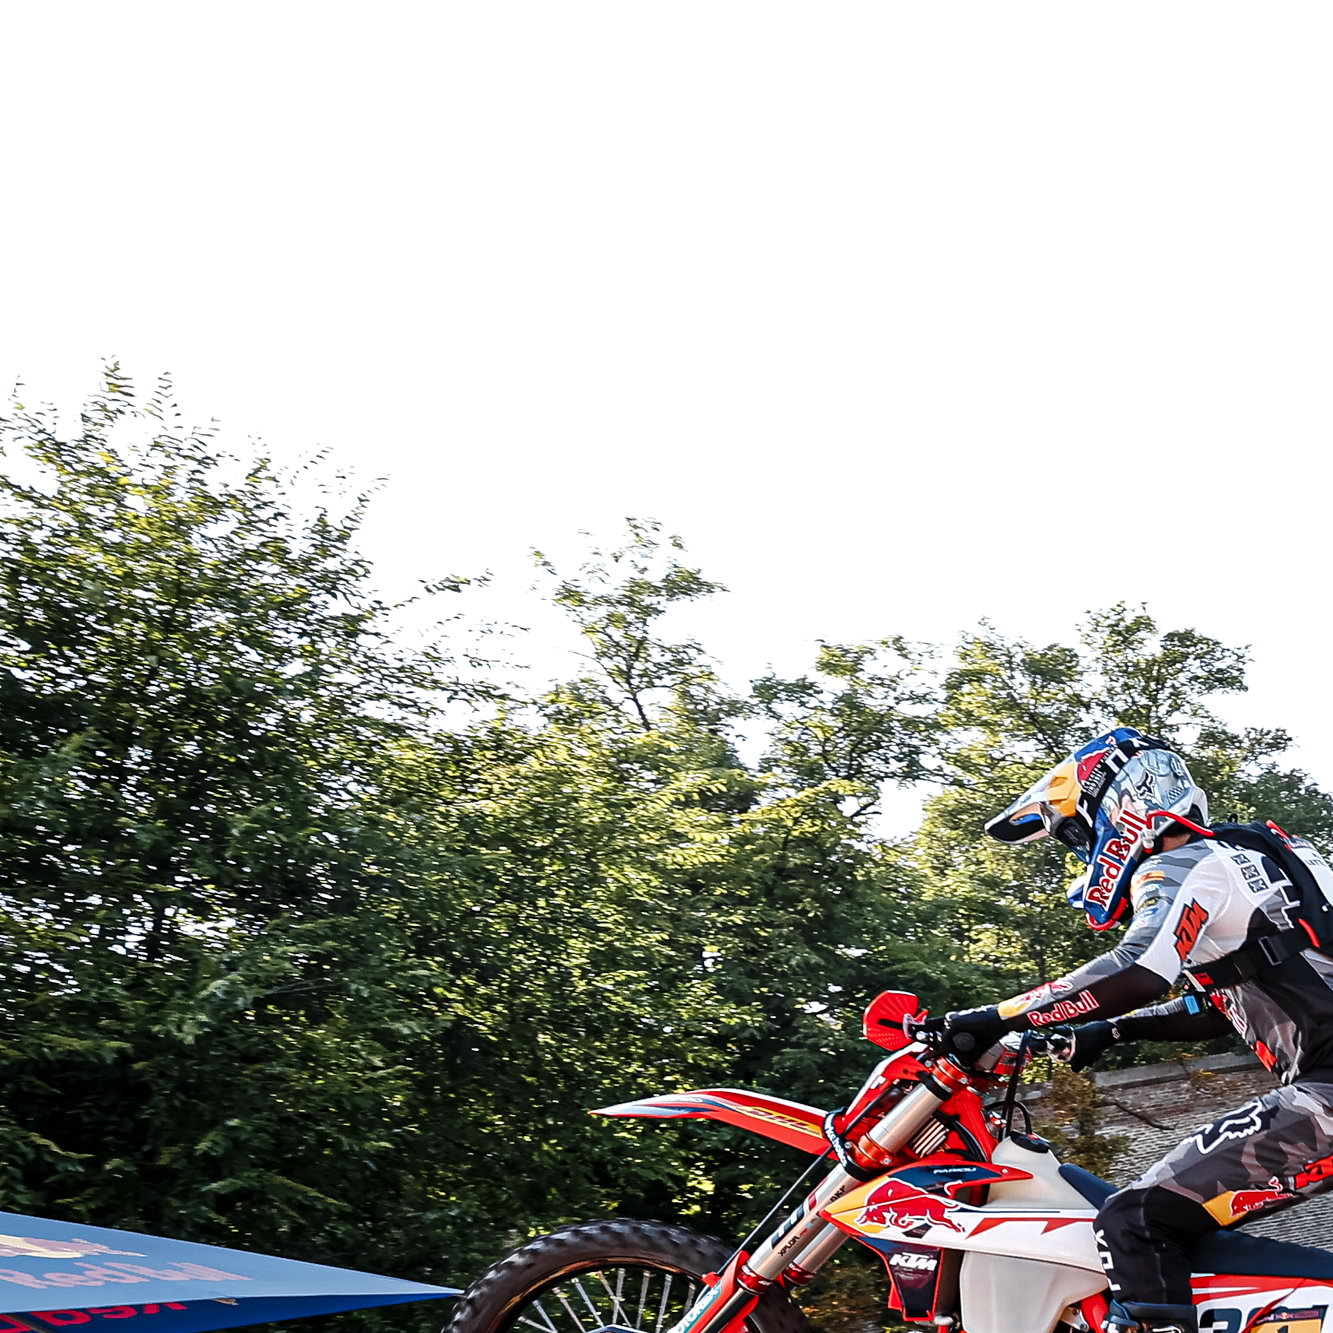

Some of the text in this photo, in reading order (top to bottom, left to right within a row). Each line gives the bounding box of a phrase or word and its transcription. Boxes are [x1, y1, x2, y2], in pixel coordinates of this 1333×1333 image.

[1085, 809, 1148, 911] Red Bull
[1173, 898, 1209, 961] KTM
[1026, 989, 1100, 1027] Red Bull
[889, 1251, 938, 1271] KTM
